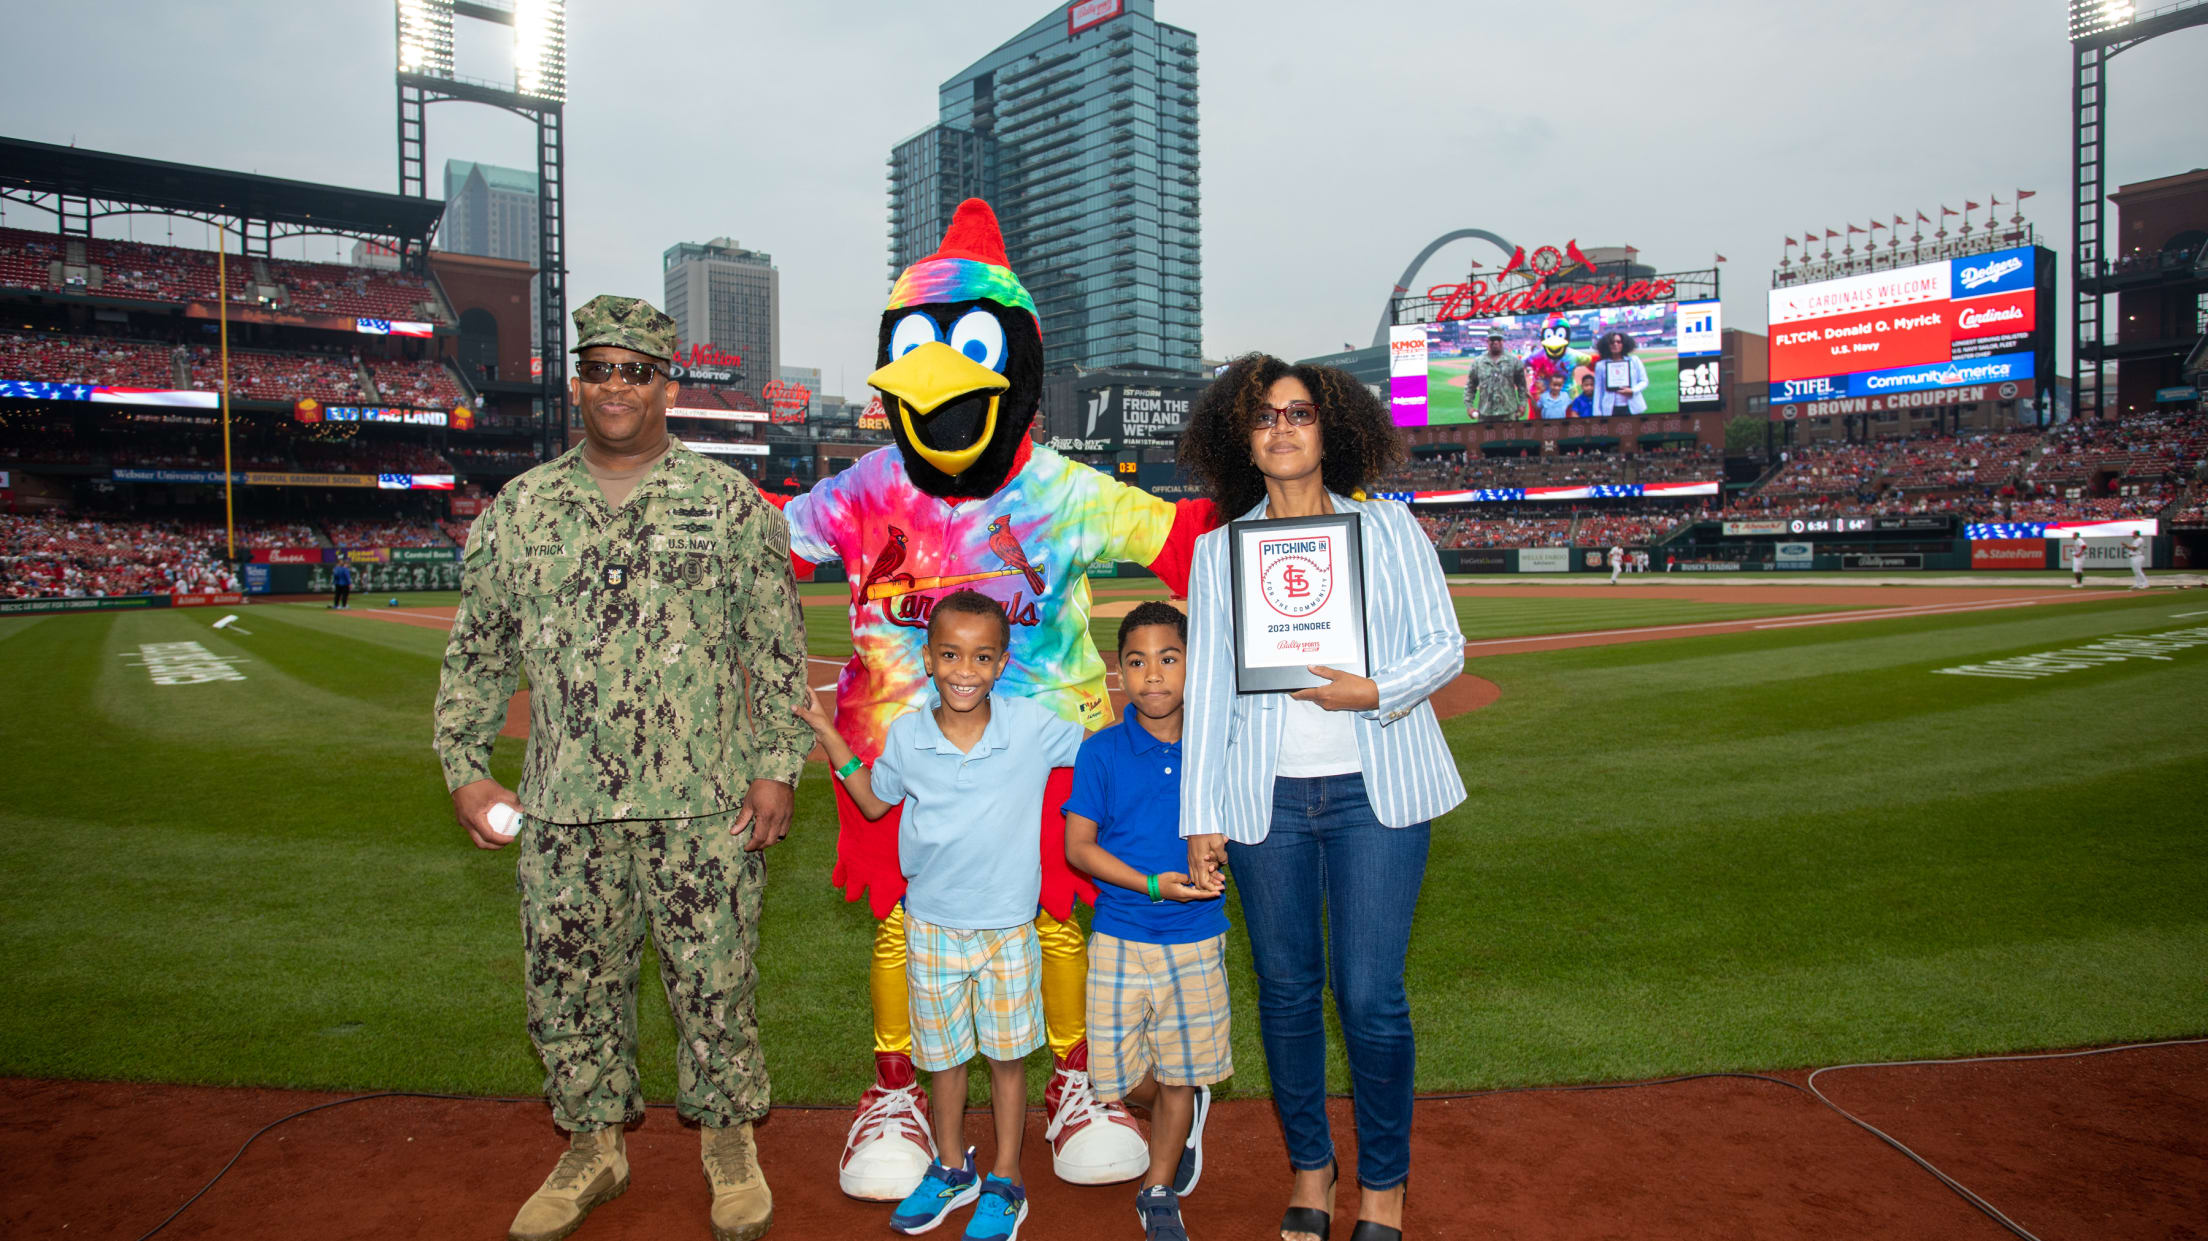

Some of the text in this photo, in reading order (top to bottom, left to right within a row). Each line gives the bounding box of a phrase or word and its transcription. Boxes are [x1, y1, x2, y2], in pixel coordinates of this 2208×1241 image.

[1795, 234, 2005, 279] WORLD CHAMPIONS
[1960, 257, 2022, 289] Dodgers
[1427, 278, 1675, 322] Budweiser
[1809, 278, 1938, 308] CARDINALS WELCOME
[1959, 306, 2024, 329] Cardinals
[1776, 313, 1941, 345] FLTCM. Donald O. Myrick
[1392, 340, 1425, 349] KMOX
[1831, 342, 1880, 355] U.S. Navy
[1999, 340, 2017, 349] FLEET
[682, 344, 741, 368] Nation
[1679, 362, 1719, 387] stl
[1680, 385, 1719, 396] TODAY
[1784, 377, 1834, 397] STIFEL
[1122, 398, 1189, 412] FROM THE
[1807, 400, 1867, 417] BROWN
[1872, 400, 1881, 410] &
[1887, 387, 1985, 408] CROUPPEN
[326, 407, 448, 426] BIG MAC LAND
[1122, 411, 1180, 425] LOU AND
[113, 469, 154, 480] Webster
[157, 470, 205, 483] University
[207, 472, 240, 482] Onlne
[333, 476, 362, 484] SCHOOL
[1807, 521, 1828, 531] 6:54
[1881, 521, 1900, 529] Mercy
[525, 544, 564, 557] MYRICK
[668, 538, 717, 551] U.S. NAVY
[1264, 541, 1327, 555] PITCHING IN
[404, 551, 432, 559] Central
[433, 551, 454, 559] Bank
[1681, 563, 1705, 571] BUSCH
[1707, 563, 1740, 571] STADIUM
[1266, 577, 1327, 612] FOR THE COMMUNITY
[52, 601, 64, 609] FOR
[1268, 621, 1331, 633] 2023 HONOREE
[1277, 640, 1301, 650] Bally
